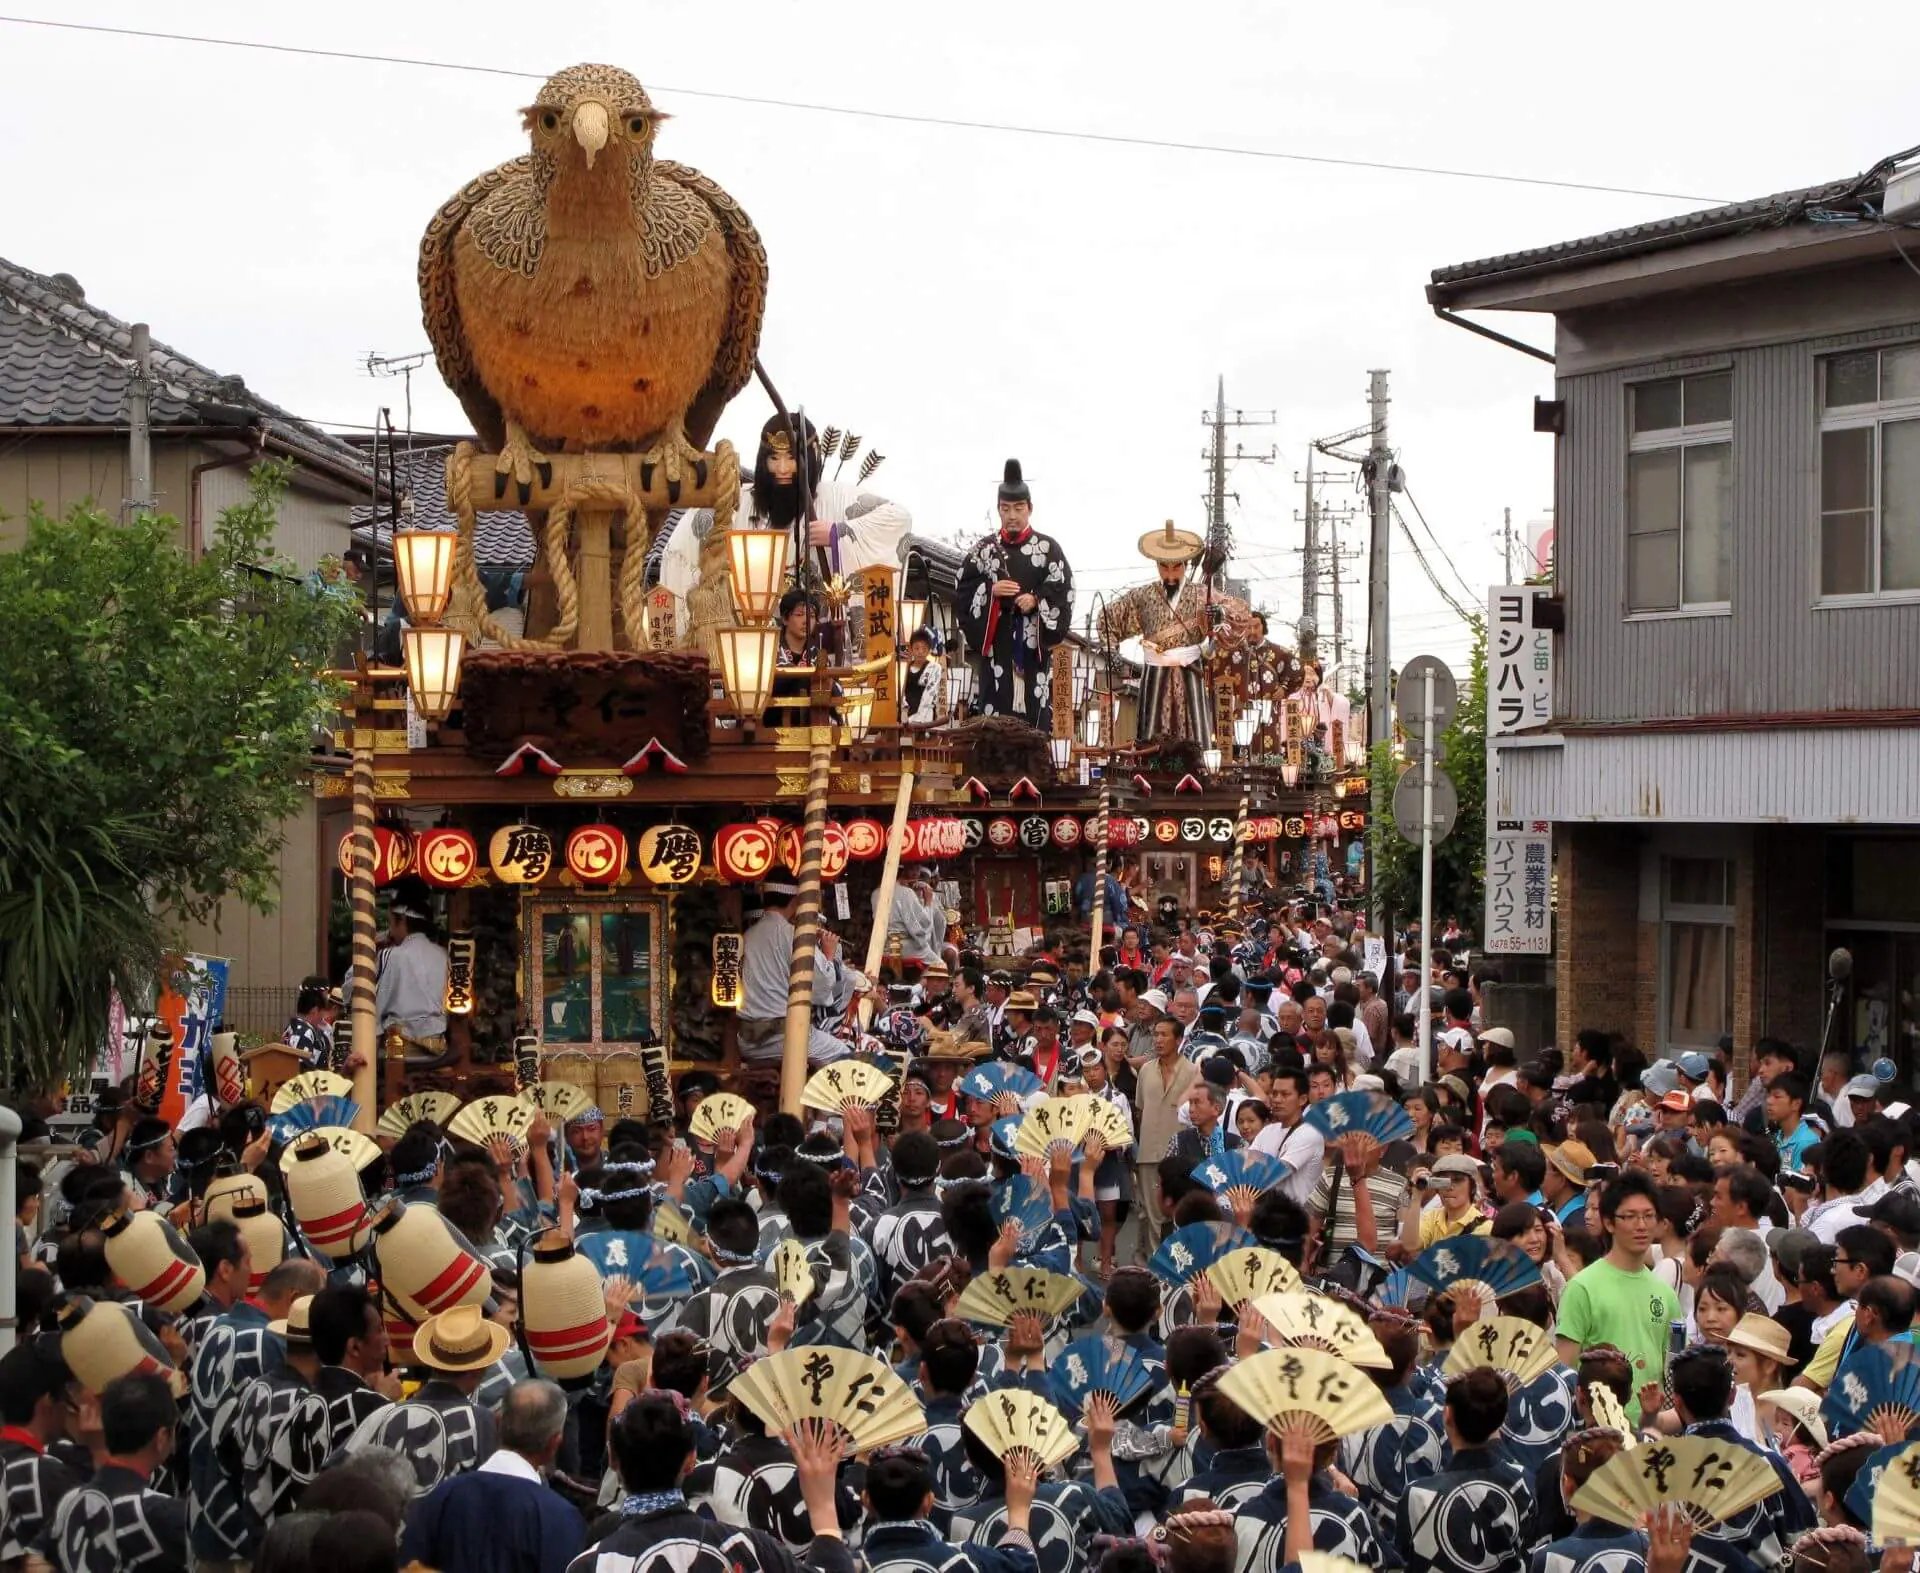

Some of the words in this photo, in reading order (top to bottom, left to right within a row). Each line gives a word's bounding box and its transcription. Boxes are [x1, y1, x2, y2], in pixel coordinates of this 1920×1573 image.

[655, 593, 669, 609] 祝
[867, 577, 892, 639] 神武
[1497, 596, 1524, 735] ヨシハラ
[1493, 839, 1516, 934] パイプハウス
[1524, 843, 1546, 929] 農業資材
[1510, 936, 1549, 951] 55-1131
